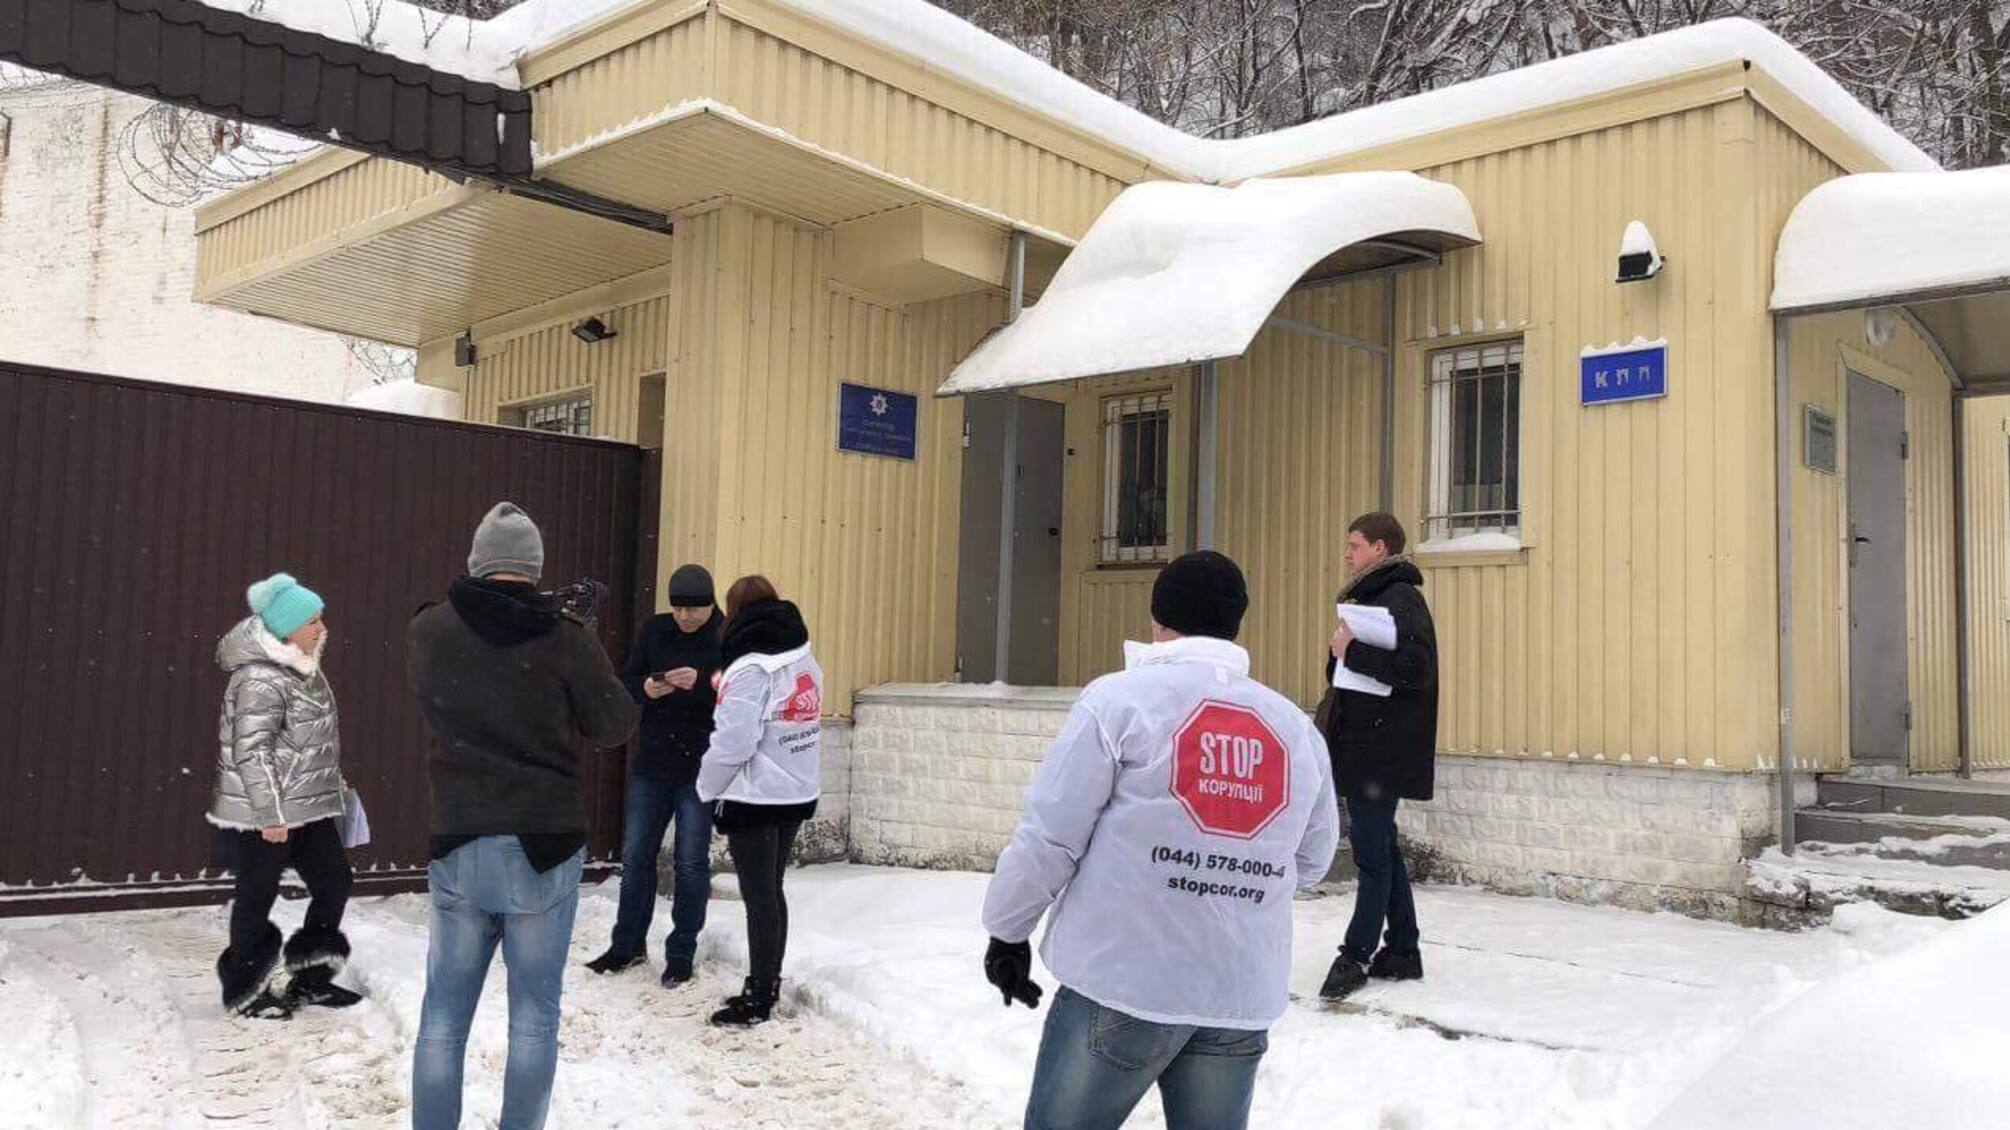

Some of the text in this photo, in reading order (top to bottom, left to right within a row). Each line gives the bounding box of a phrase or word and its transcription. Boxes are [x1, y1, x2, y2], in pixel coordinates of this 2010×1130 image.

[1199, 732, 1264, 779] STOP
[1199, 778, 1264, 804] КОРУПЦІЇ
[1151, 845, 1201, 871] (044)
[1167, 876, 1265, 904] stopcor.org
